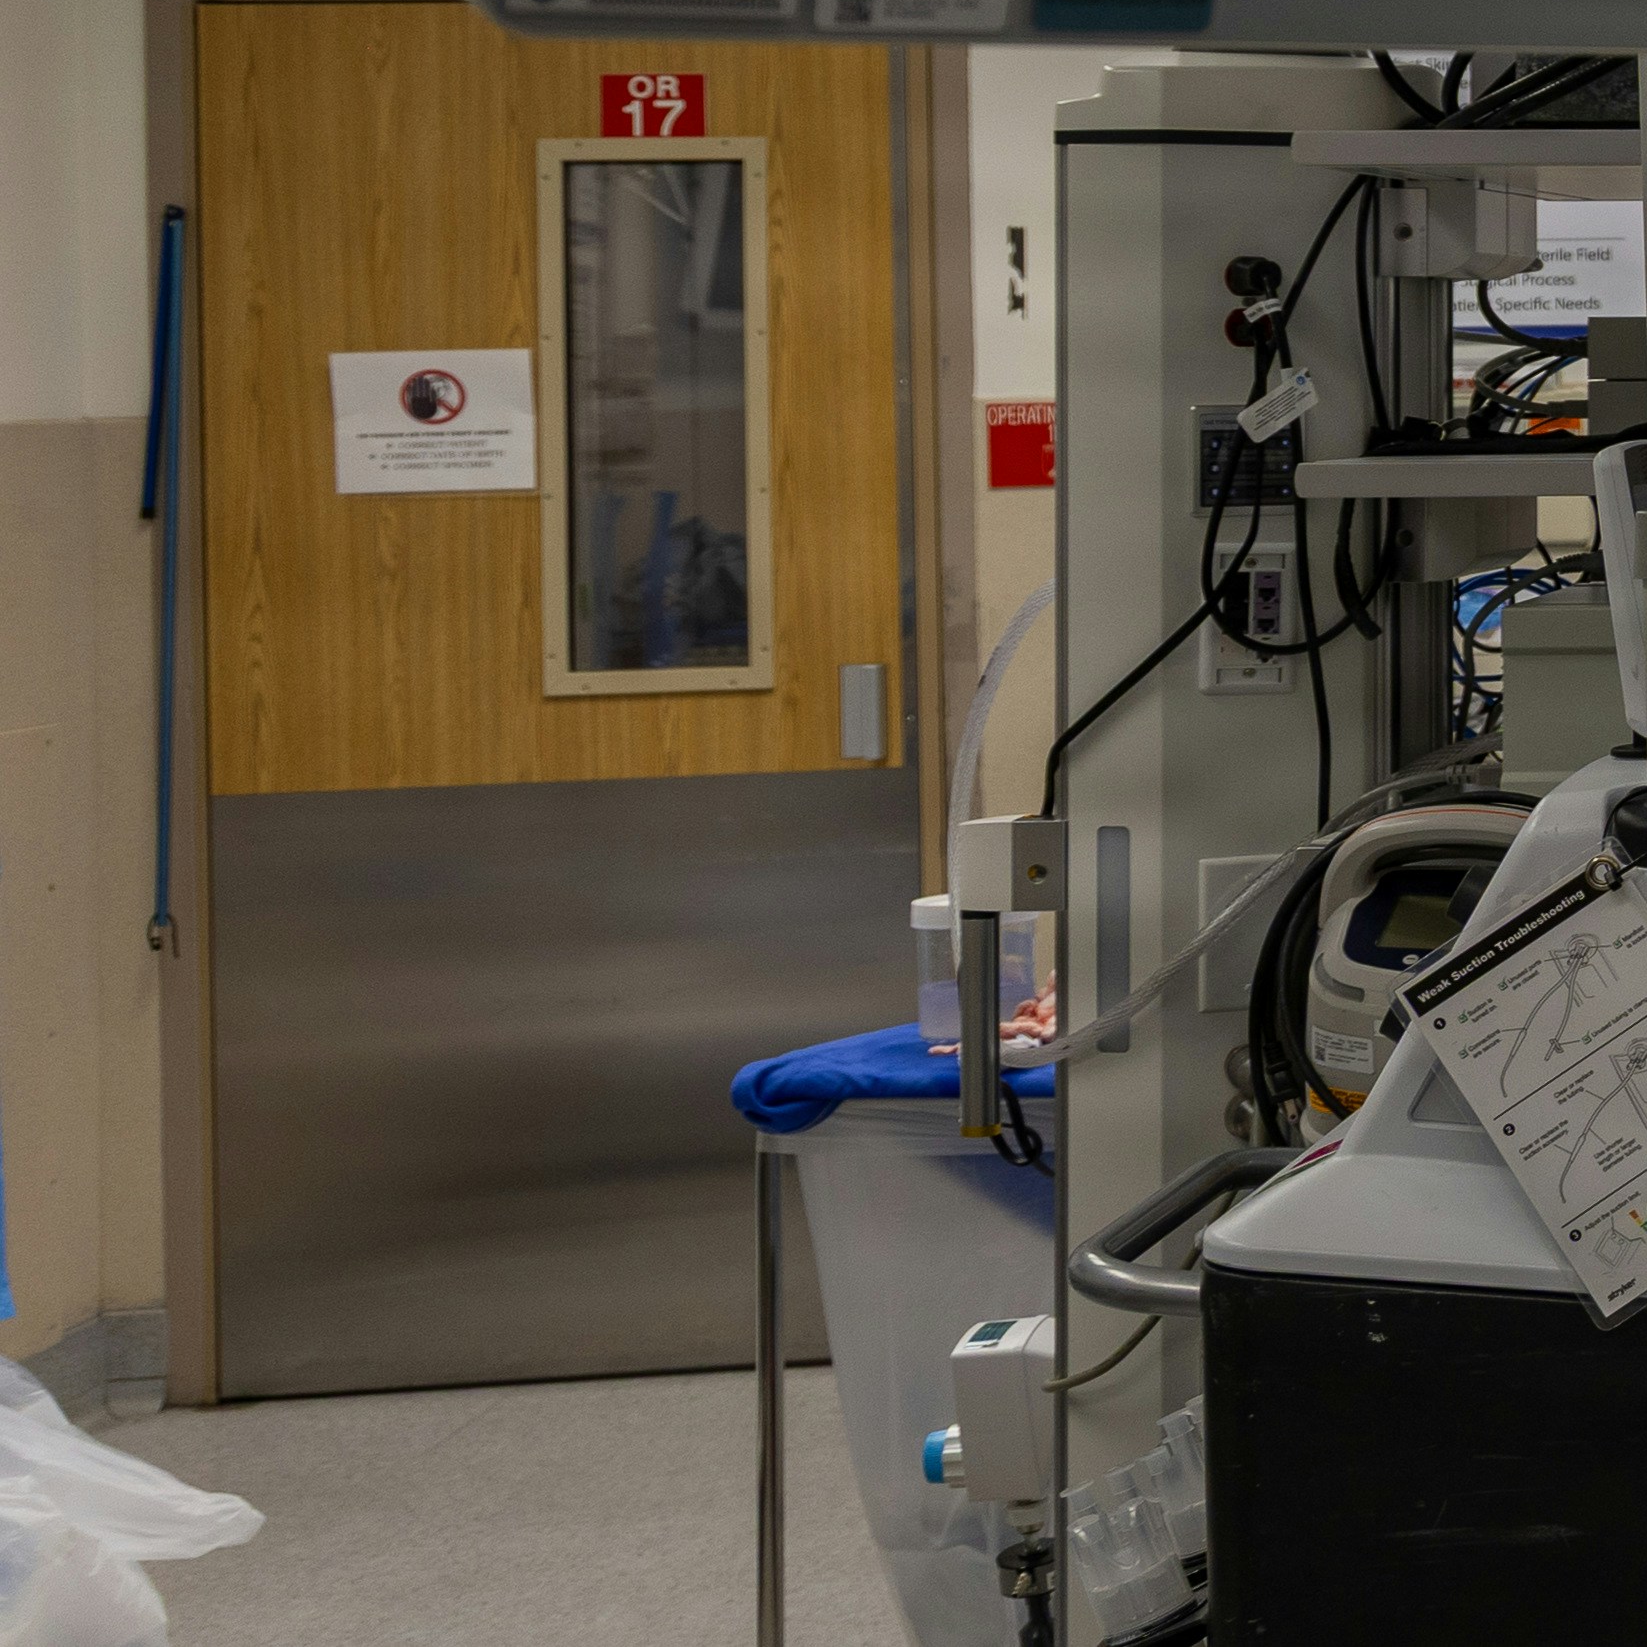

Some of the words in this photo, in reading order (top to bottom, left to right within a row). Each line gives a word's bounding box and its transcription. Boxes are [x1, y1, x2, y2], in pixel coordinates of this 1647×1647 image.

[627, 75, 680, 99] OR
[621, 99, 687, 137] 17
[1538, 248, 1573, 261] erile
[1576, 248, 1611, 261] Field
[1522, 274, 1576, 287] Process
[1495, 297, 1551, 313] Specific
[1555, 297, 1602, 310] Needs
[987, 404, 1056, 425] OPERATIN
[1416, 976, 1452, 1004] Weak
[1449, 946, 1496, 981] Suction
[1493, 887, 1587, 954] Troubleshooting
[1467, 1027, 1501, 1053] Connections
[1583, 1216, 1602, 1231] Adjust
[1605, 1276, 1639, 1303] stryker
